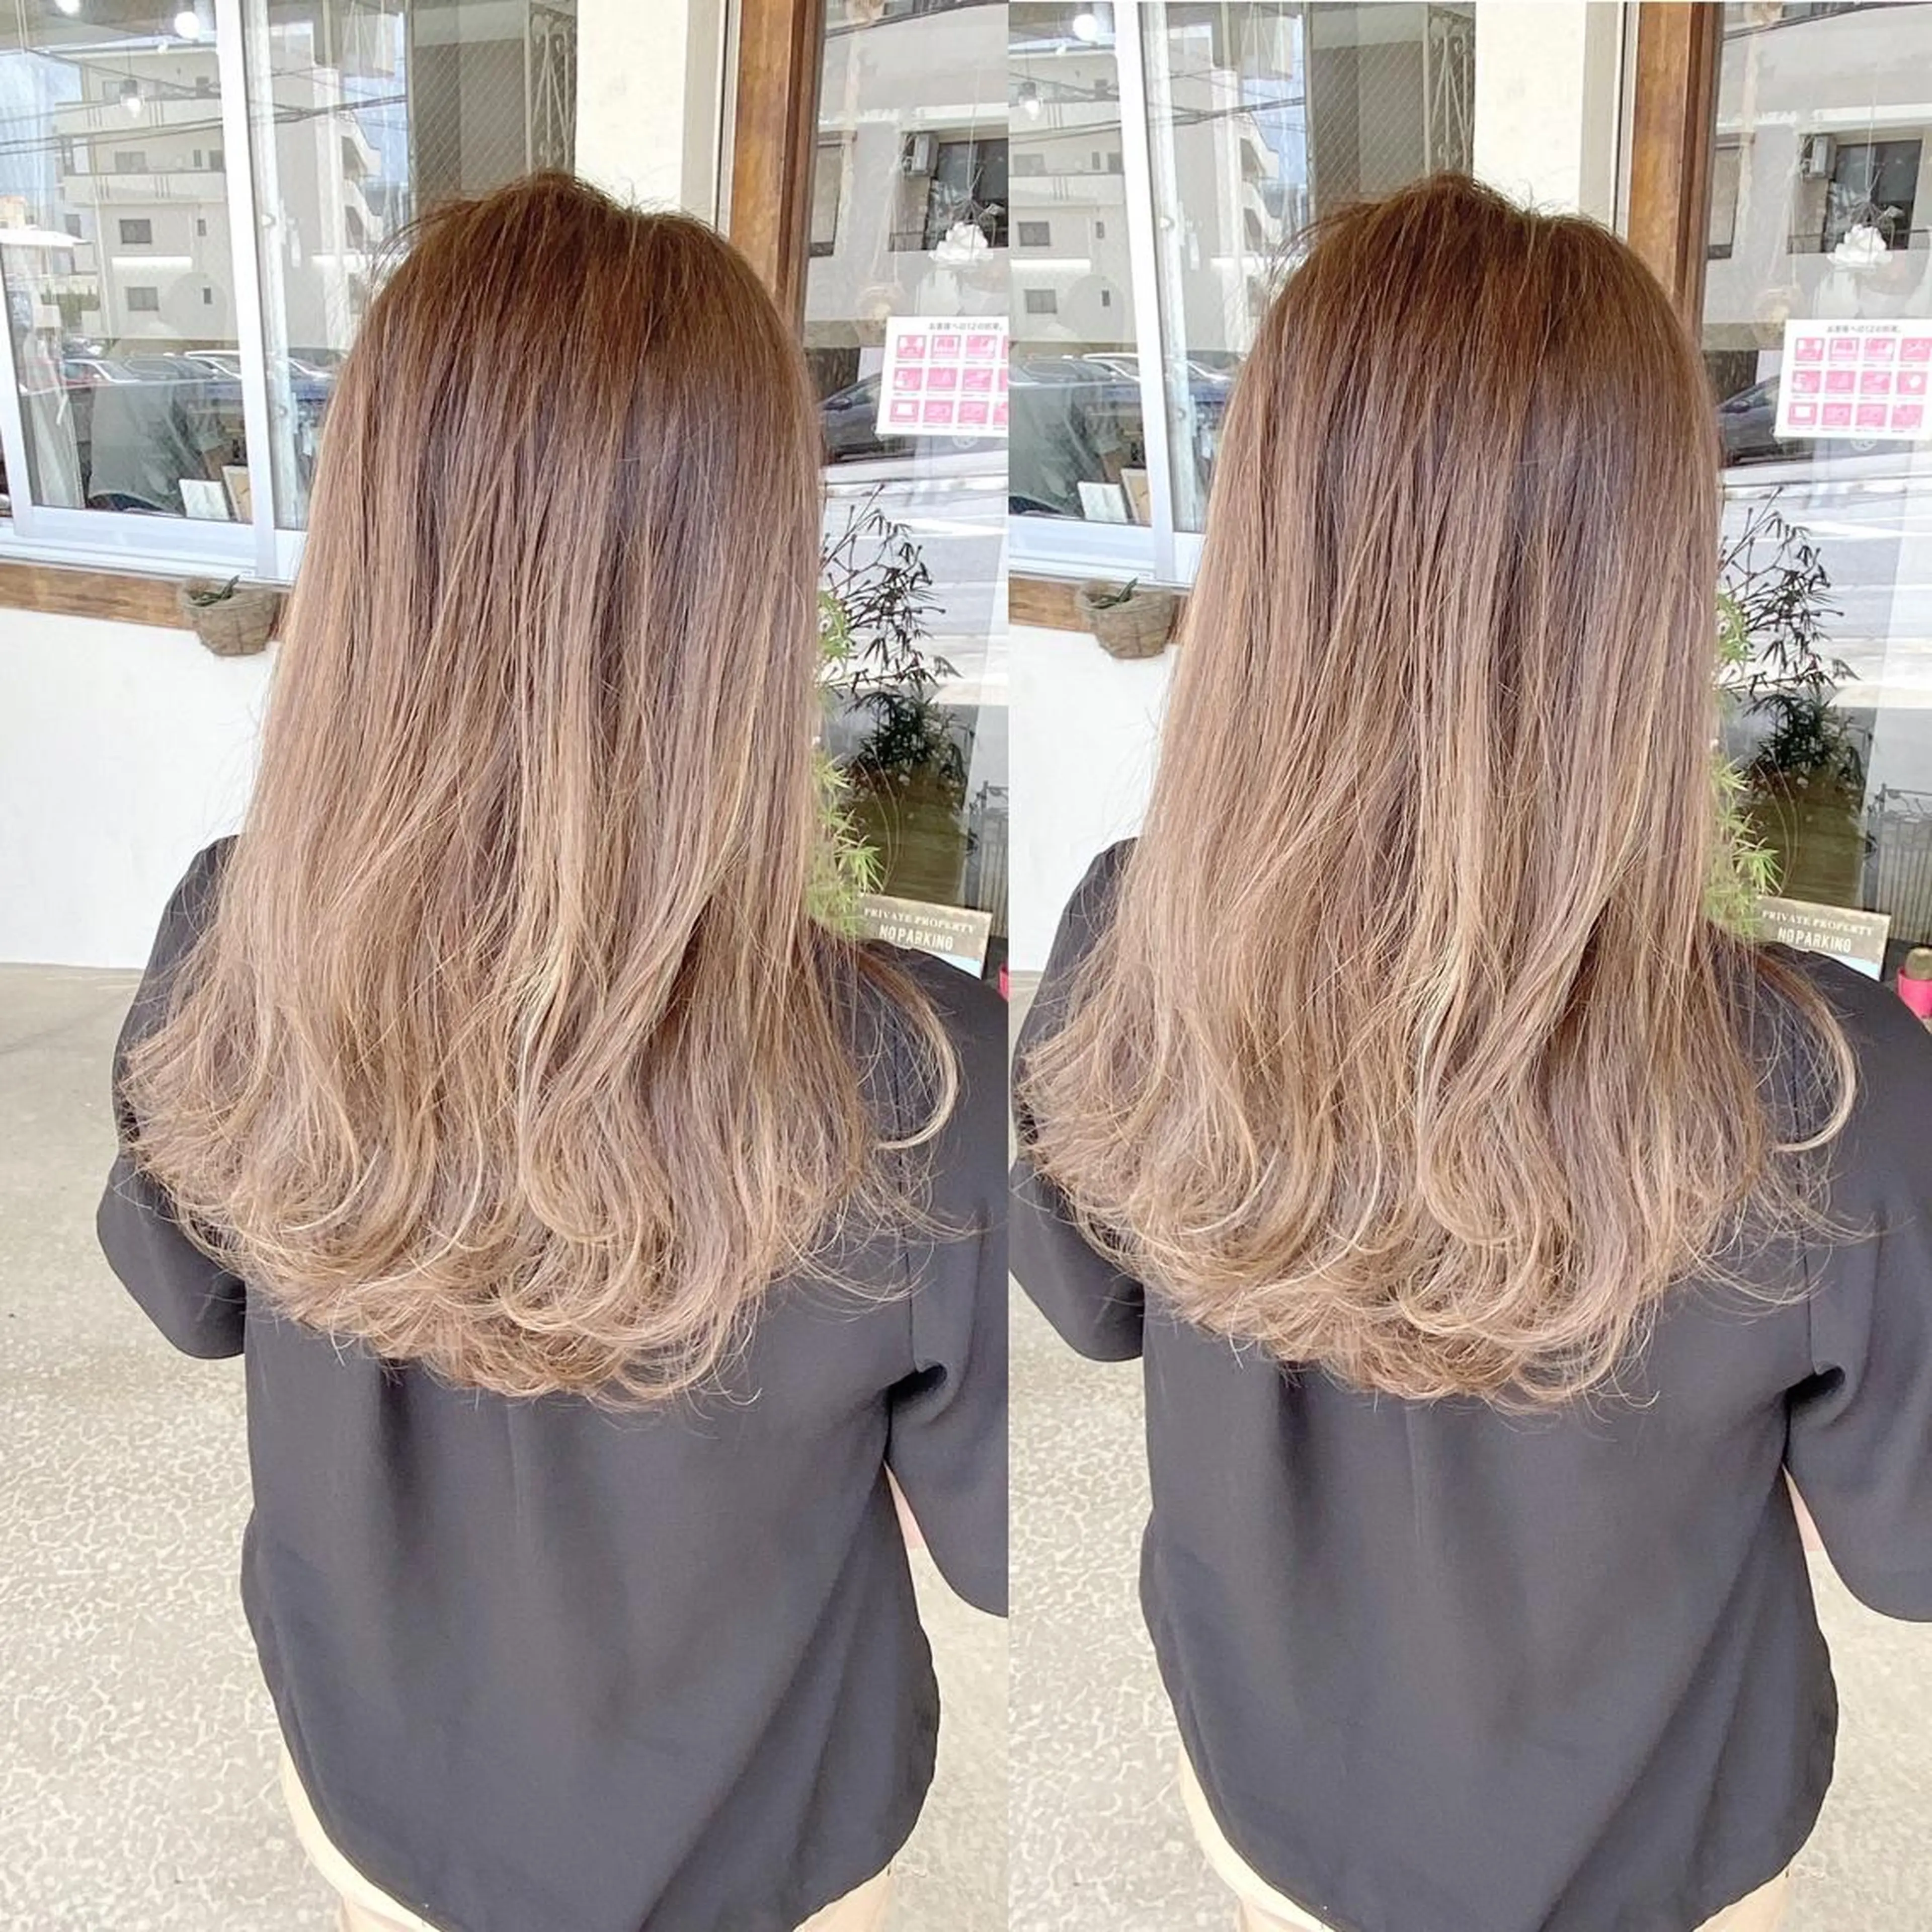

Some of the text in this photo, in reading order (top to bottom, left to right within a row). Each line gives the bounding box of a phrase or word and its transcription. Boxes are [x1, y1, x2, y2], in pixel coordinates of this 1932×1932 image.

[864, 908, 975, 934] PRIVATE PROPERTY
[1762, 910, 1873, 936] PRIVATE PROPERTY
